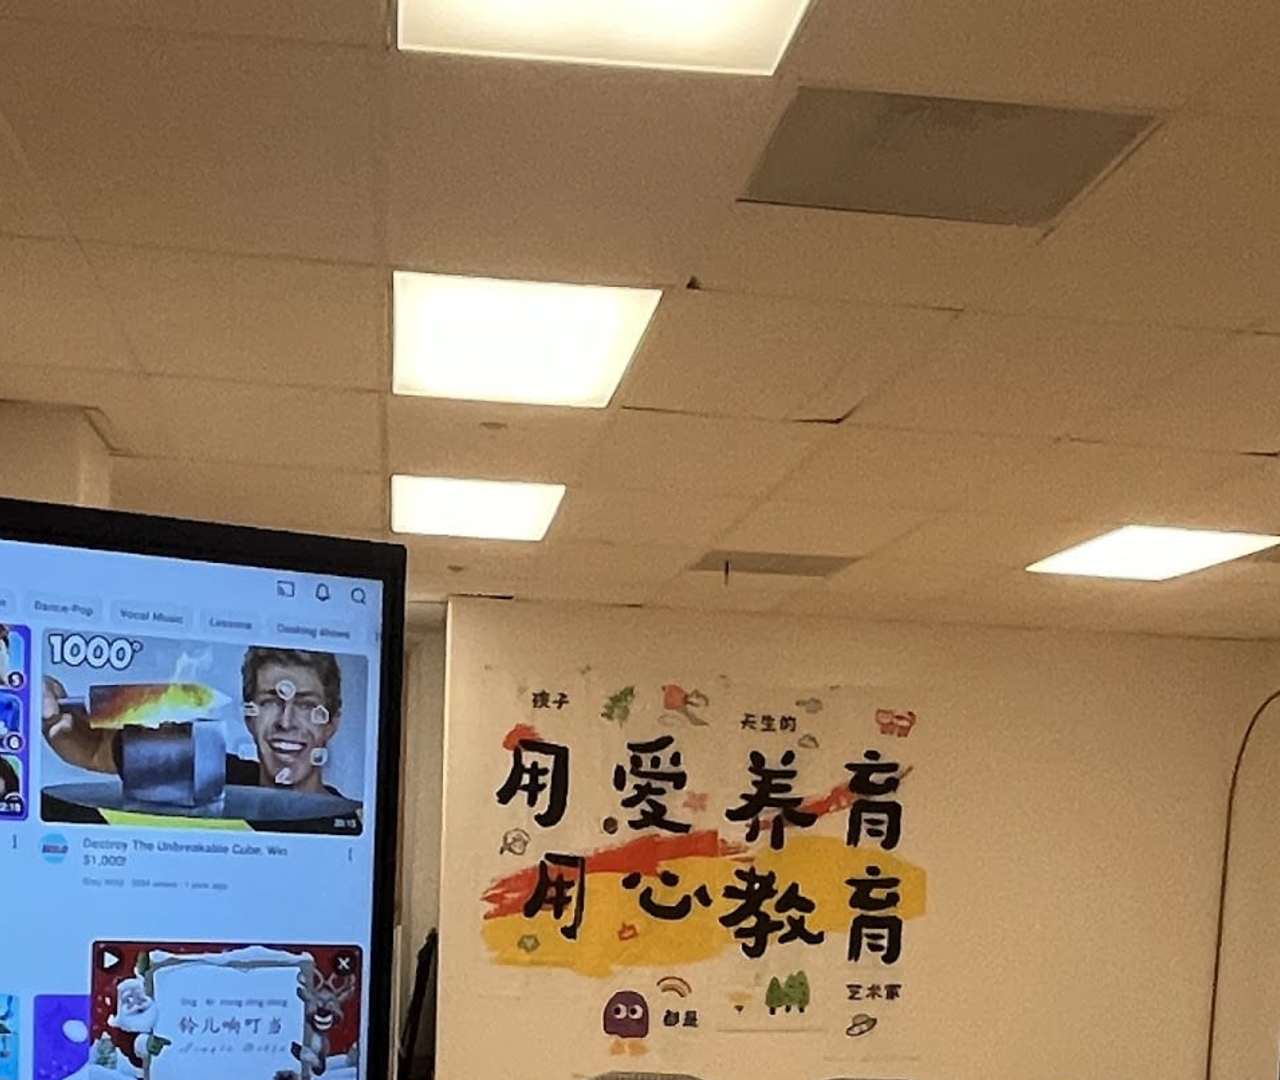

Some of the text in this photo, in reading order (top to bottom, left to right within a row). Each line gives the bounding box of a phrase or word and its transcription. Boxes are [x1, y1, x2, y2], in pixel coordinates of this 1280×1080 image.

[121, 608, 184, 625] Vocal Music
[82, 837, 128, 853] Destroy
[133, 839, 155, 852] The
[523, 853, 904, 965] 用心教育
